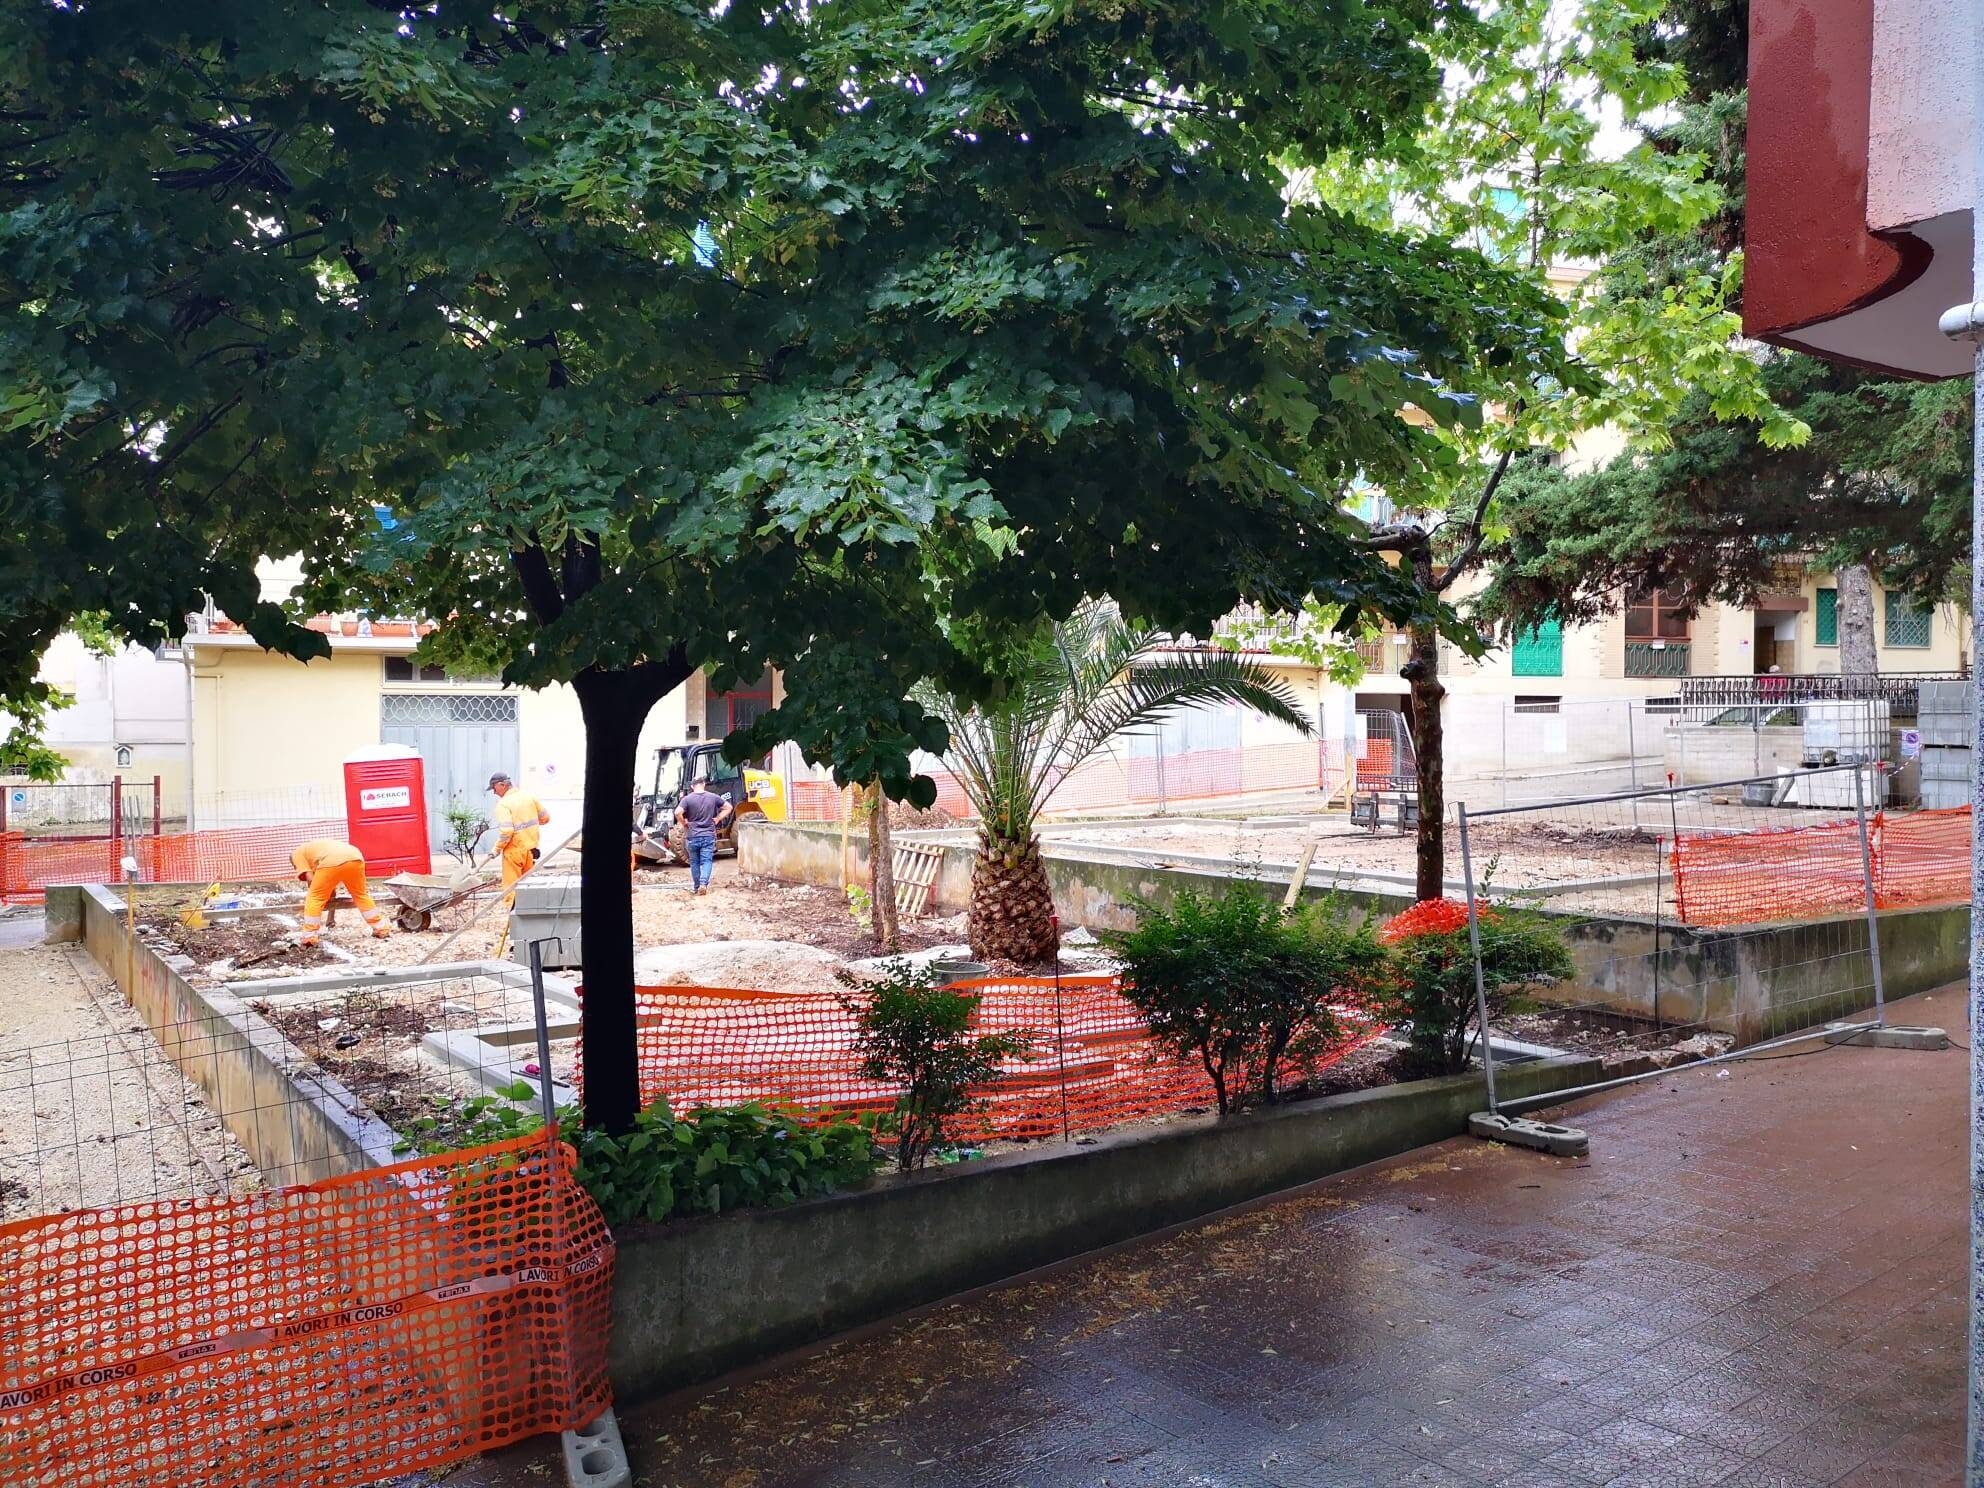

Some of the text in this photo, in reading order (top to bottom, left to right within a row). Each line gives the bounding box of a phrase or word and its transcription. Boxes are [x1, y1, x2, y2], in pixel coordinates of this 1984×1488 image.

[749, 780, 769, 789] JCB
[518, 1268, 560, 1283] LAVORI
[574, 1254, 600, 1274] CORSO
[438, 1285, 470, 1299] TENAX
[274, 1302, 404, 1337] LAVORI IN CORSO
[178, 1343, 216, 1359] TENAX
[54, 1376, 76, 1394] IN
[79, 1363, 137, 1387] CORSO
